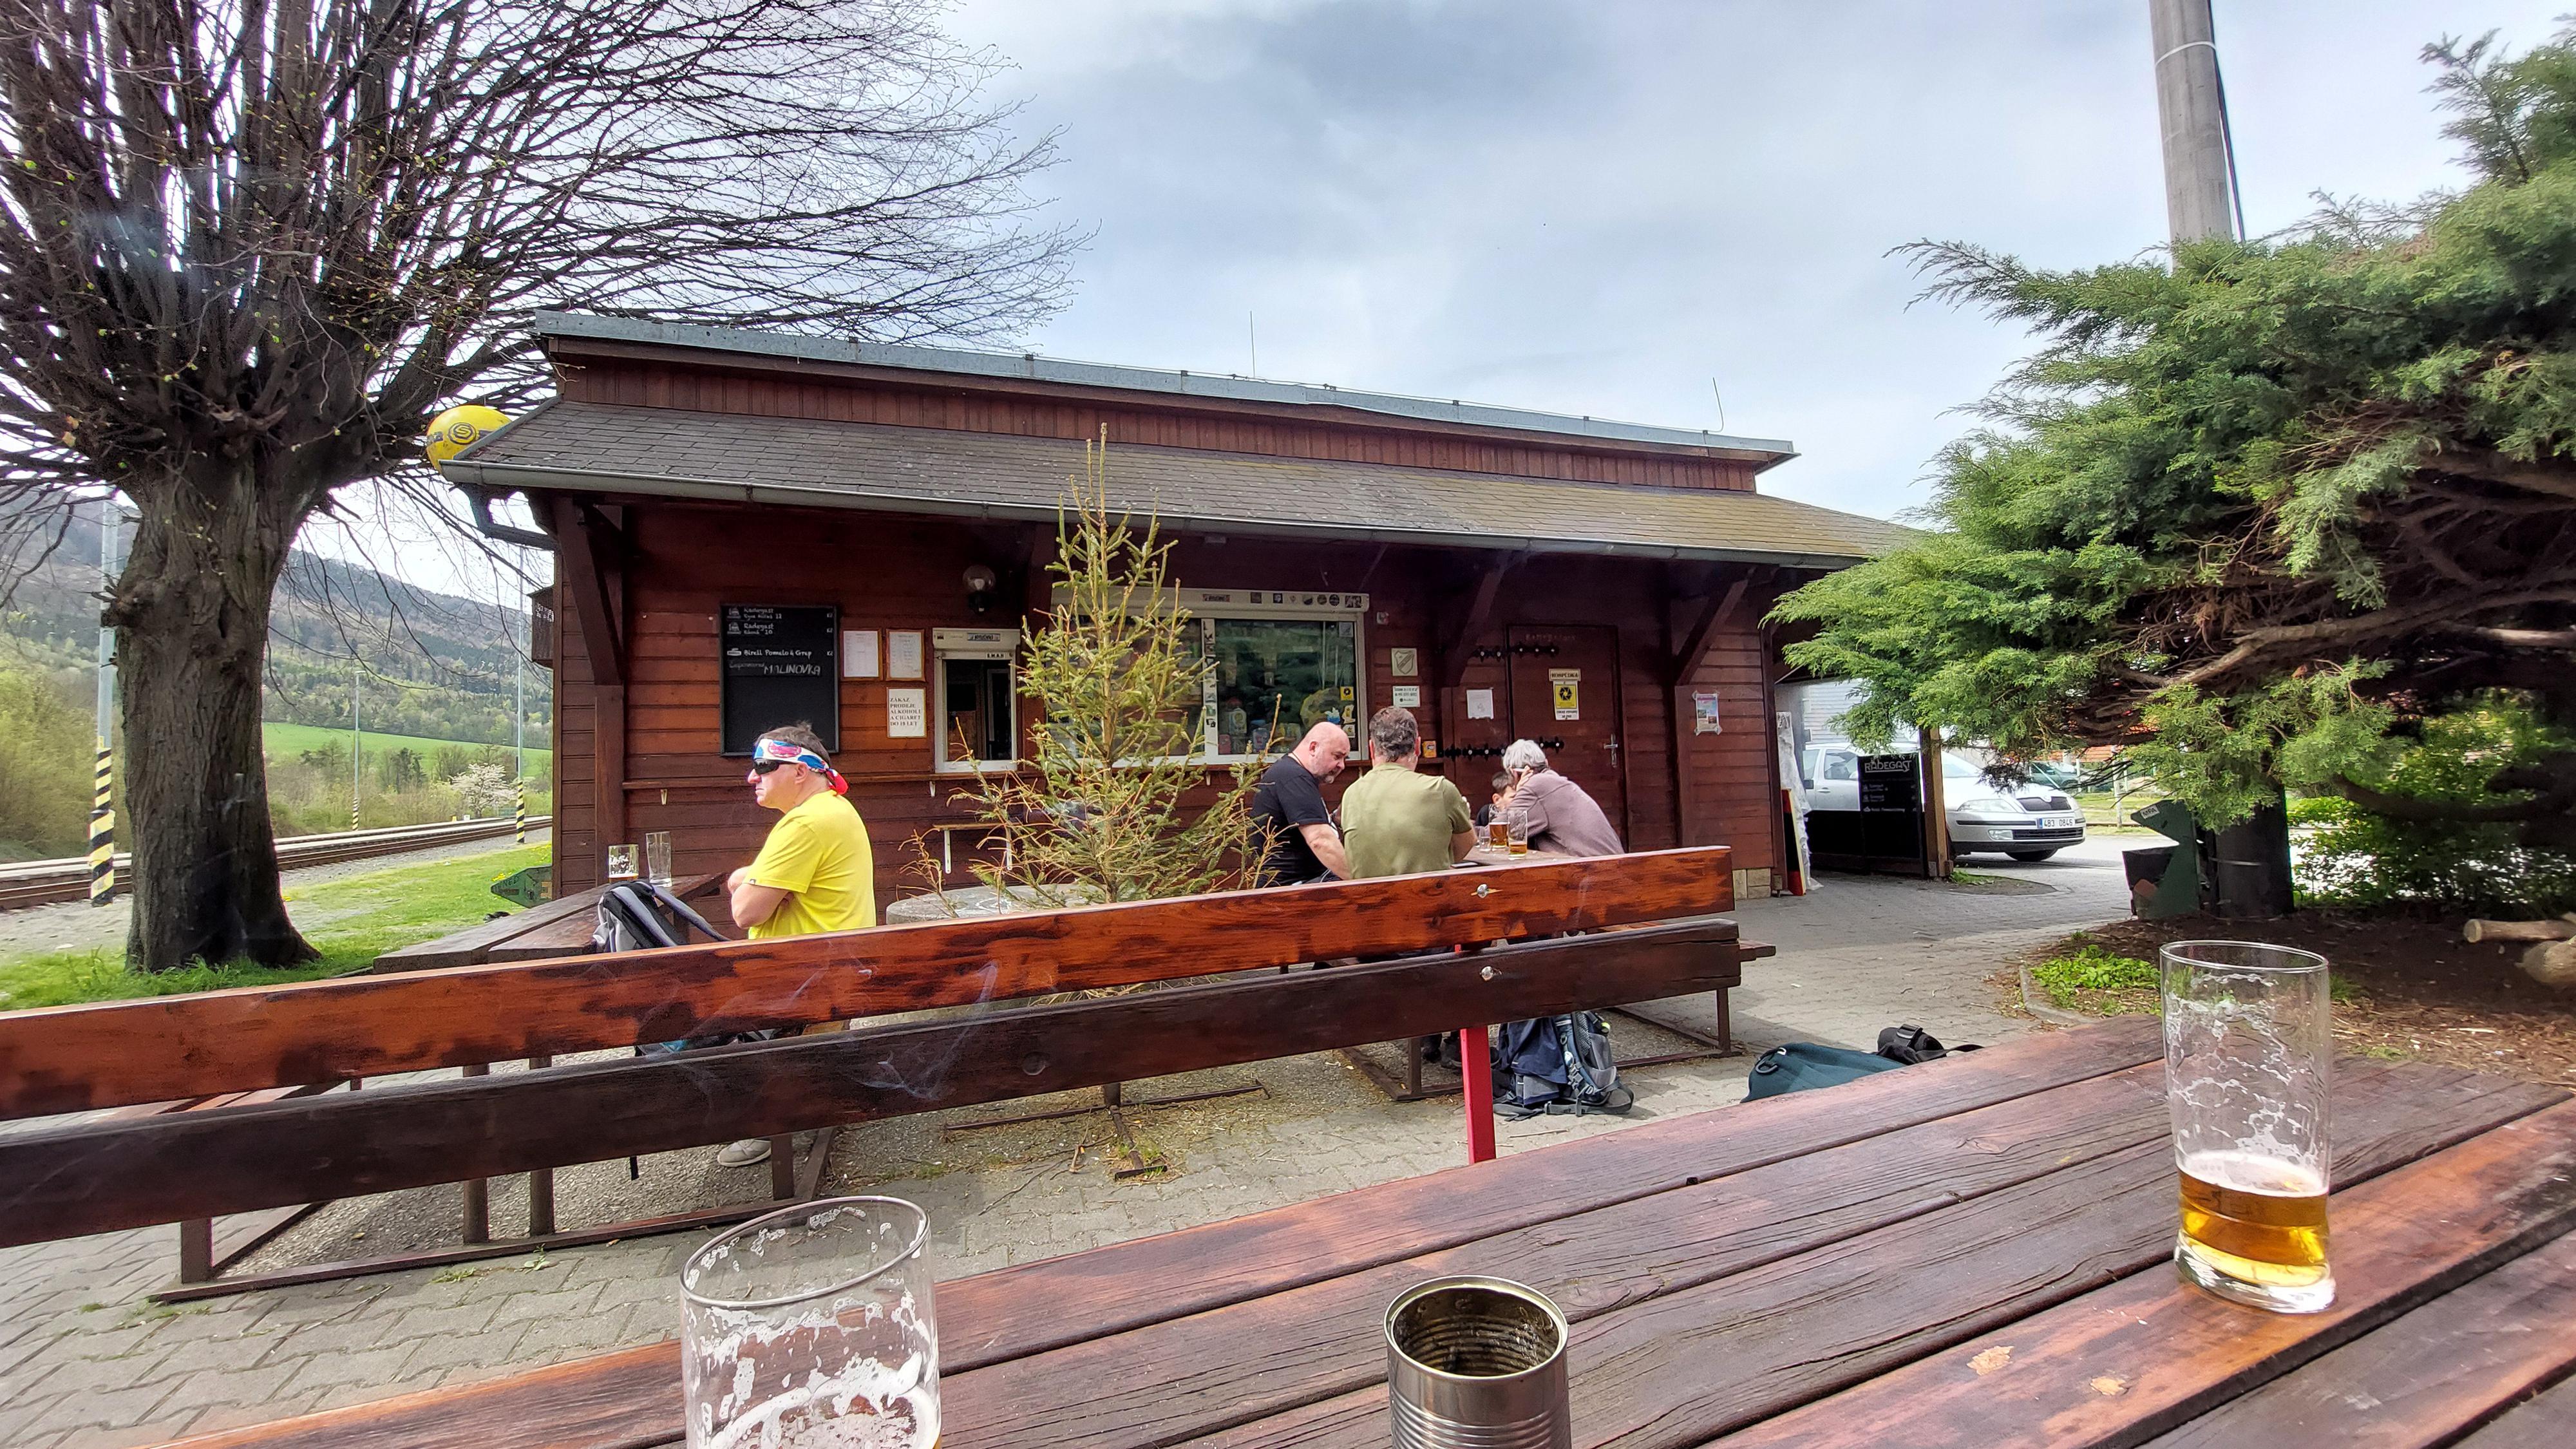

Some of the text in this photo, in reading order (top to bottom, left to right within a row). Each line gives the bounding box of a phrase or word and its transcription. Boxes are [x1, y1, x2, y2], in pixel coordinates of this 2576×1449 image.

[743, 623, 774, 631] Radegast
[764, 664, 821, 675] MALINOVKA
[1864, 759, 1912, 773] RADEGAST
